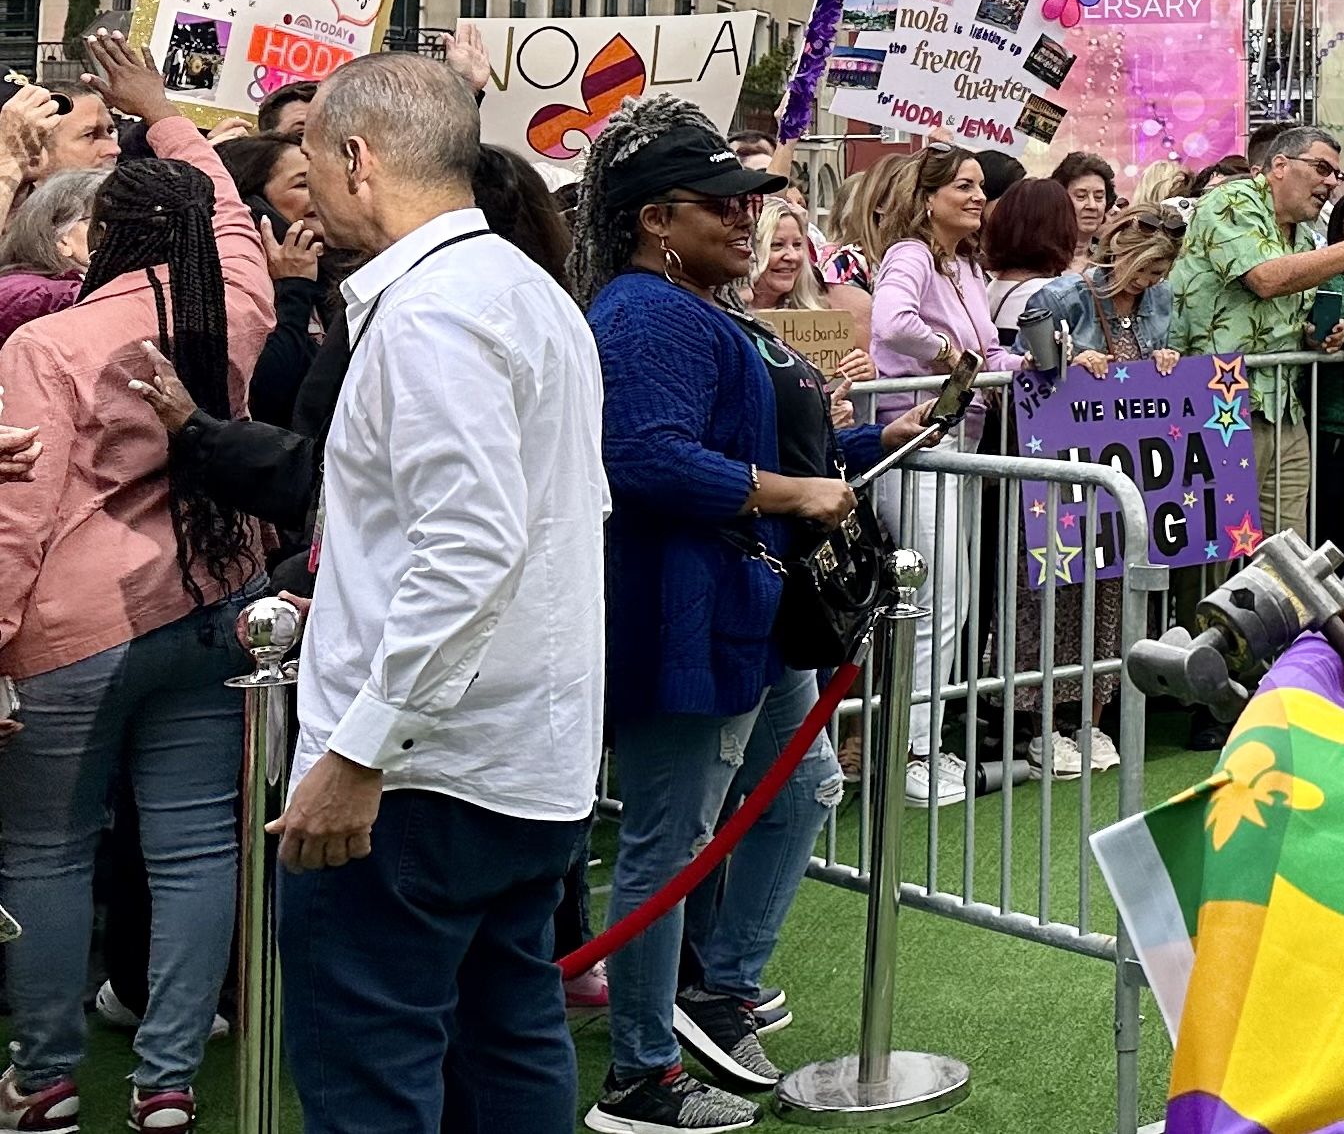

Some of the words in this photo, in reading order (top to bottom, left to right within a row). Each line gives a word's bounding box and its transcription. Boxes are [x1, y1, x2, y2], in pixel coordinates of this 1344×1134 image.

[314, 20, 349, 40] TODAY
[900, 7, 948, 33] nola
[970, 24, 1008, 51] lighting
[1009, 43, 1023, 57] up
[889, 42, 907, 55] the
[911, 40, 982, 75] french
[954, 73, 1031, 104] quarter
[877, 92, 894, 105] for
[891, 99, 945, 129] HODA
[957, 115, 1015, 145] JENNA
[783, 319, 849, 343] Husbands
[1016, 372, 1034, 393] 5
[1070, 399, 1104, 422] WE
[1114, 397, 1171, 421] NEED
[1182, 397, 1195, 417] A
[1057, 431, 1216, 505] HODA
